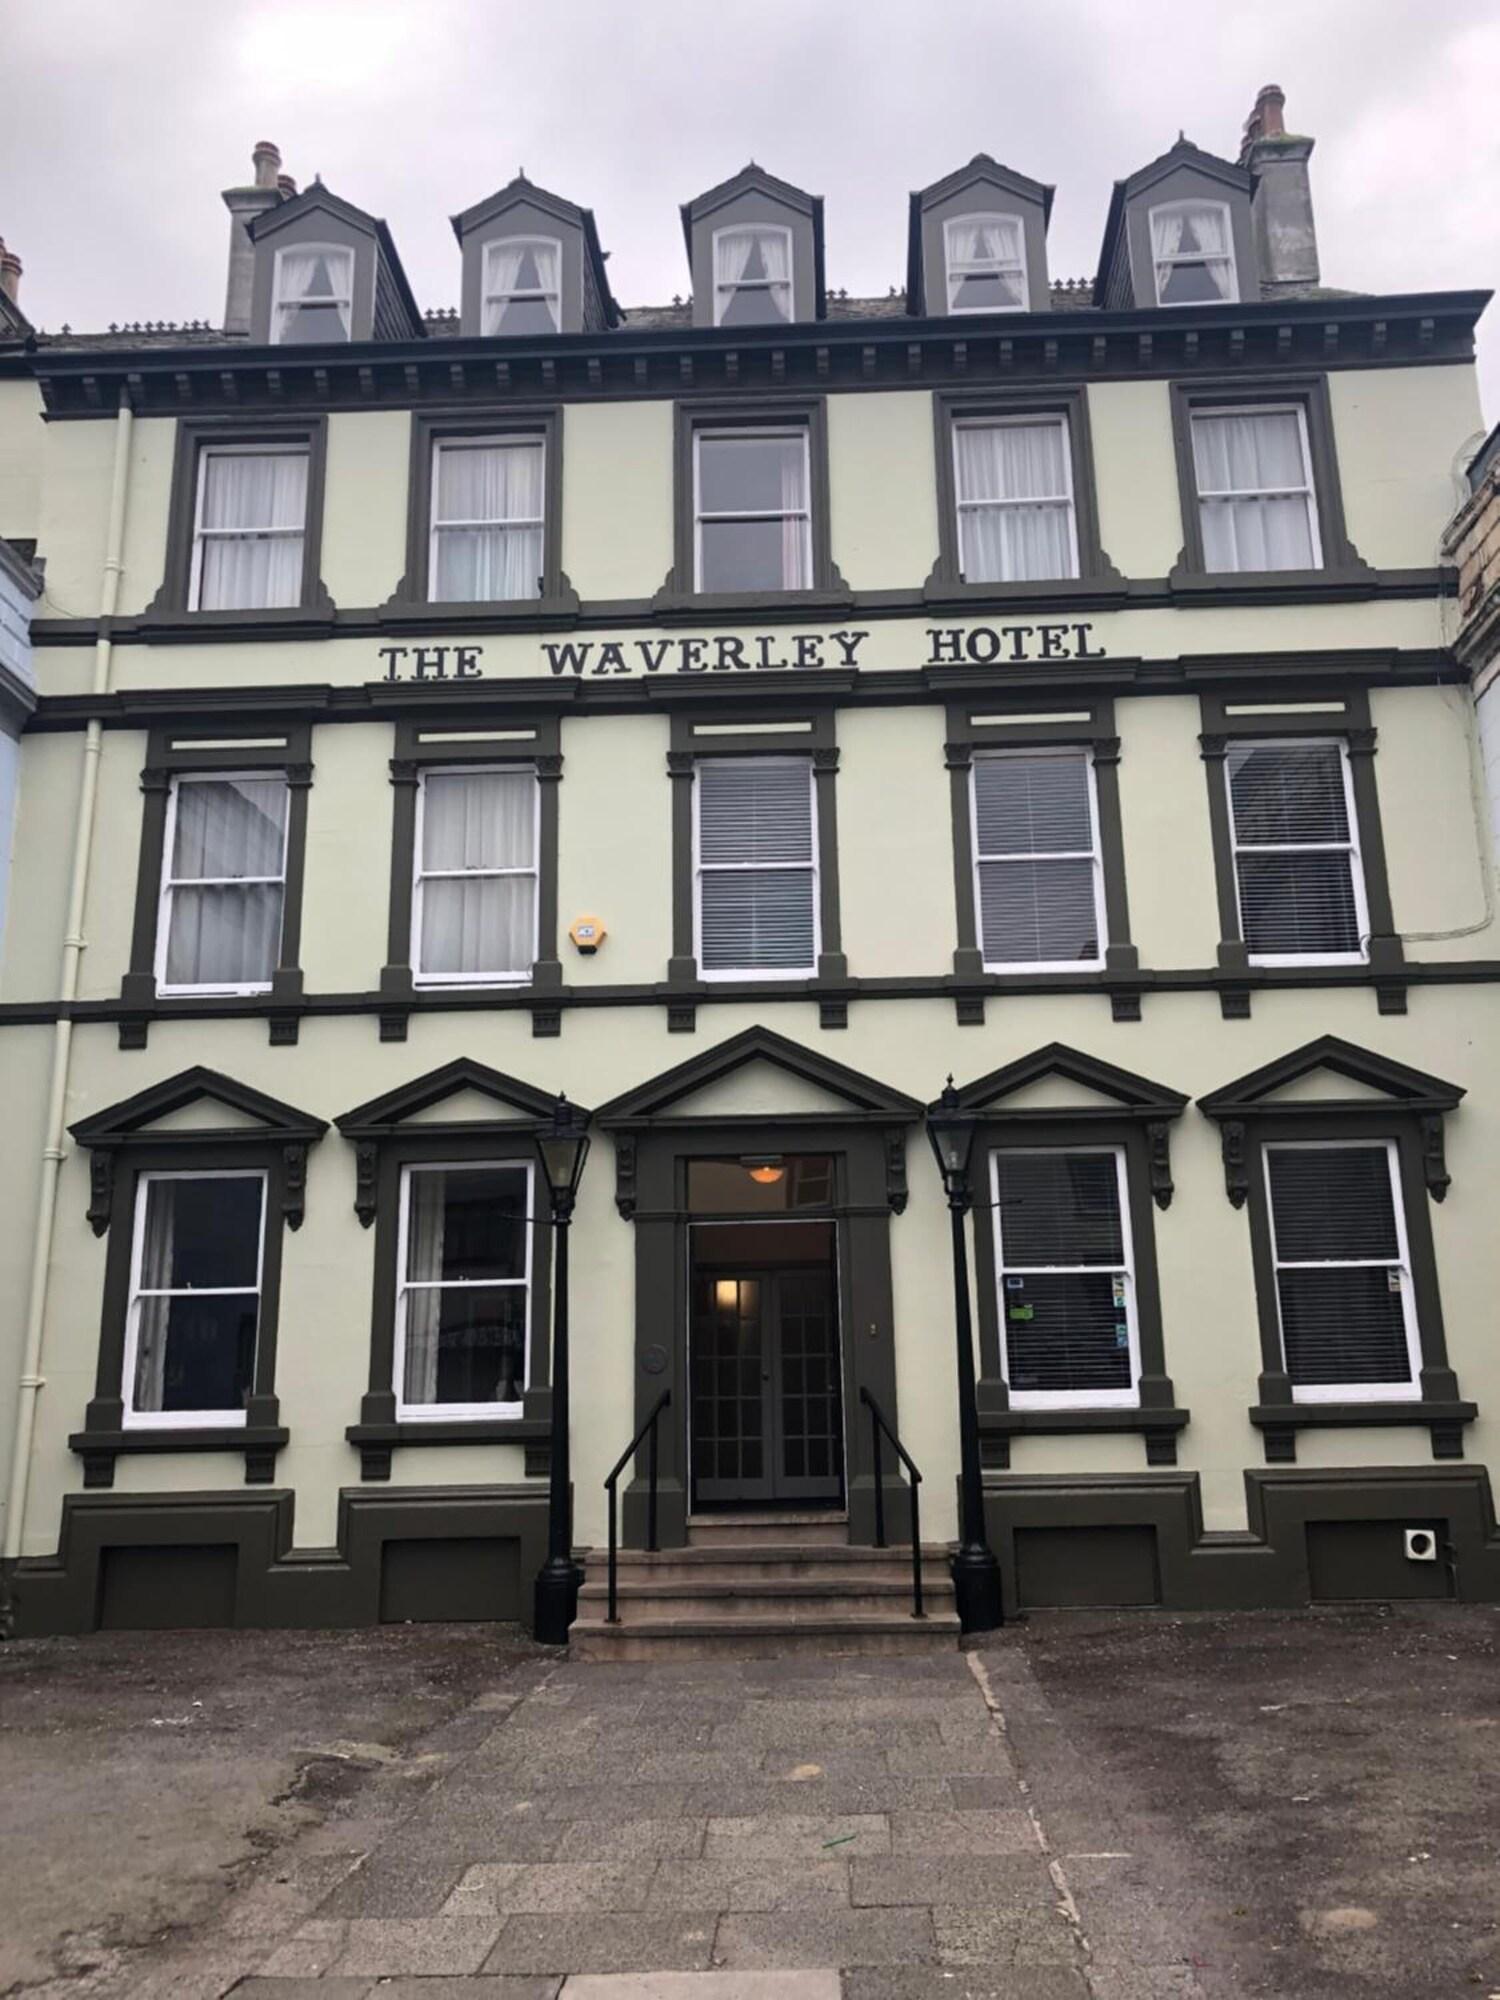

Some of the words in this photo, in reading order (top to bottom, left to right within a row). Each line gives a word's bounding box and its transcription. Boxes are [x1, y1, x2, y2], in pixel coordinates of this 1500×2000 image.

[379, 646, 483, 681] THE
[541, 631, 870, 675] WAVERLEY
[926, 623, 1106, 664] HOTEL
